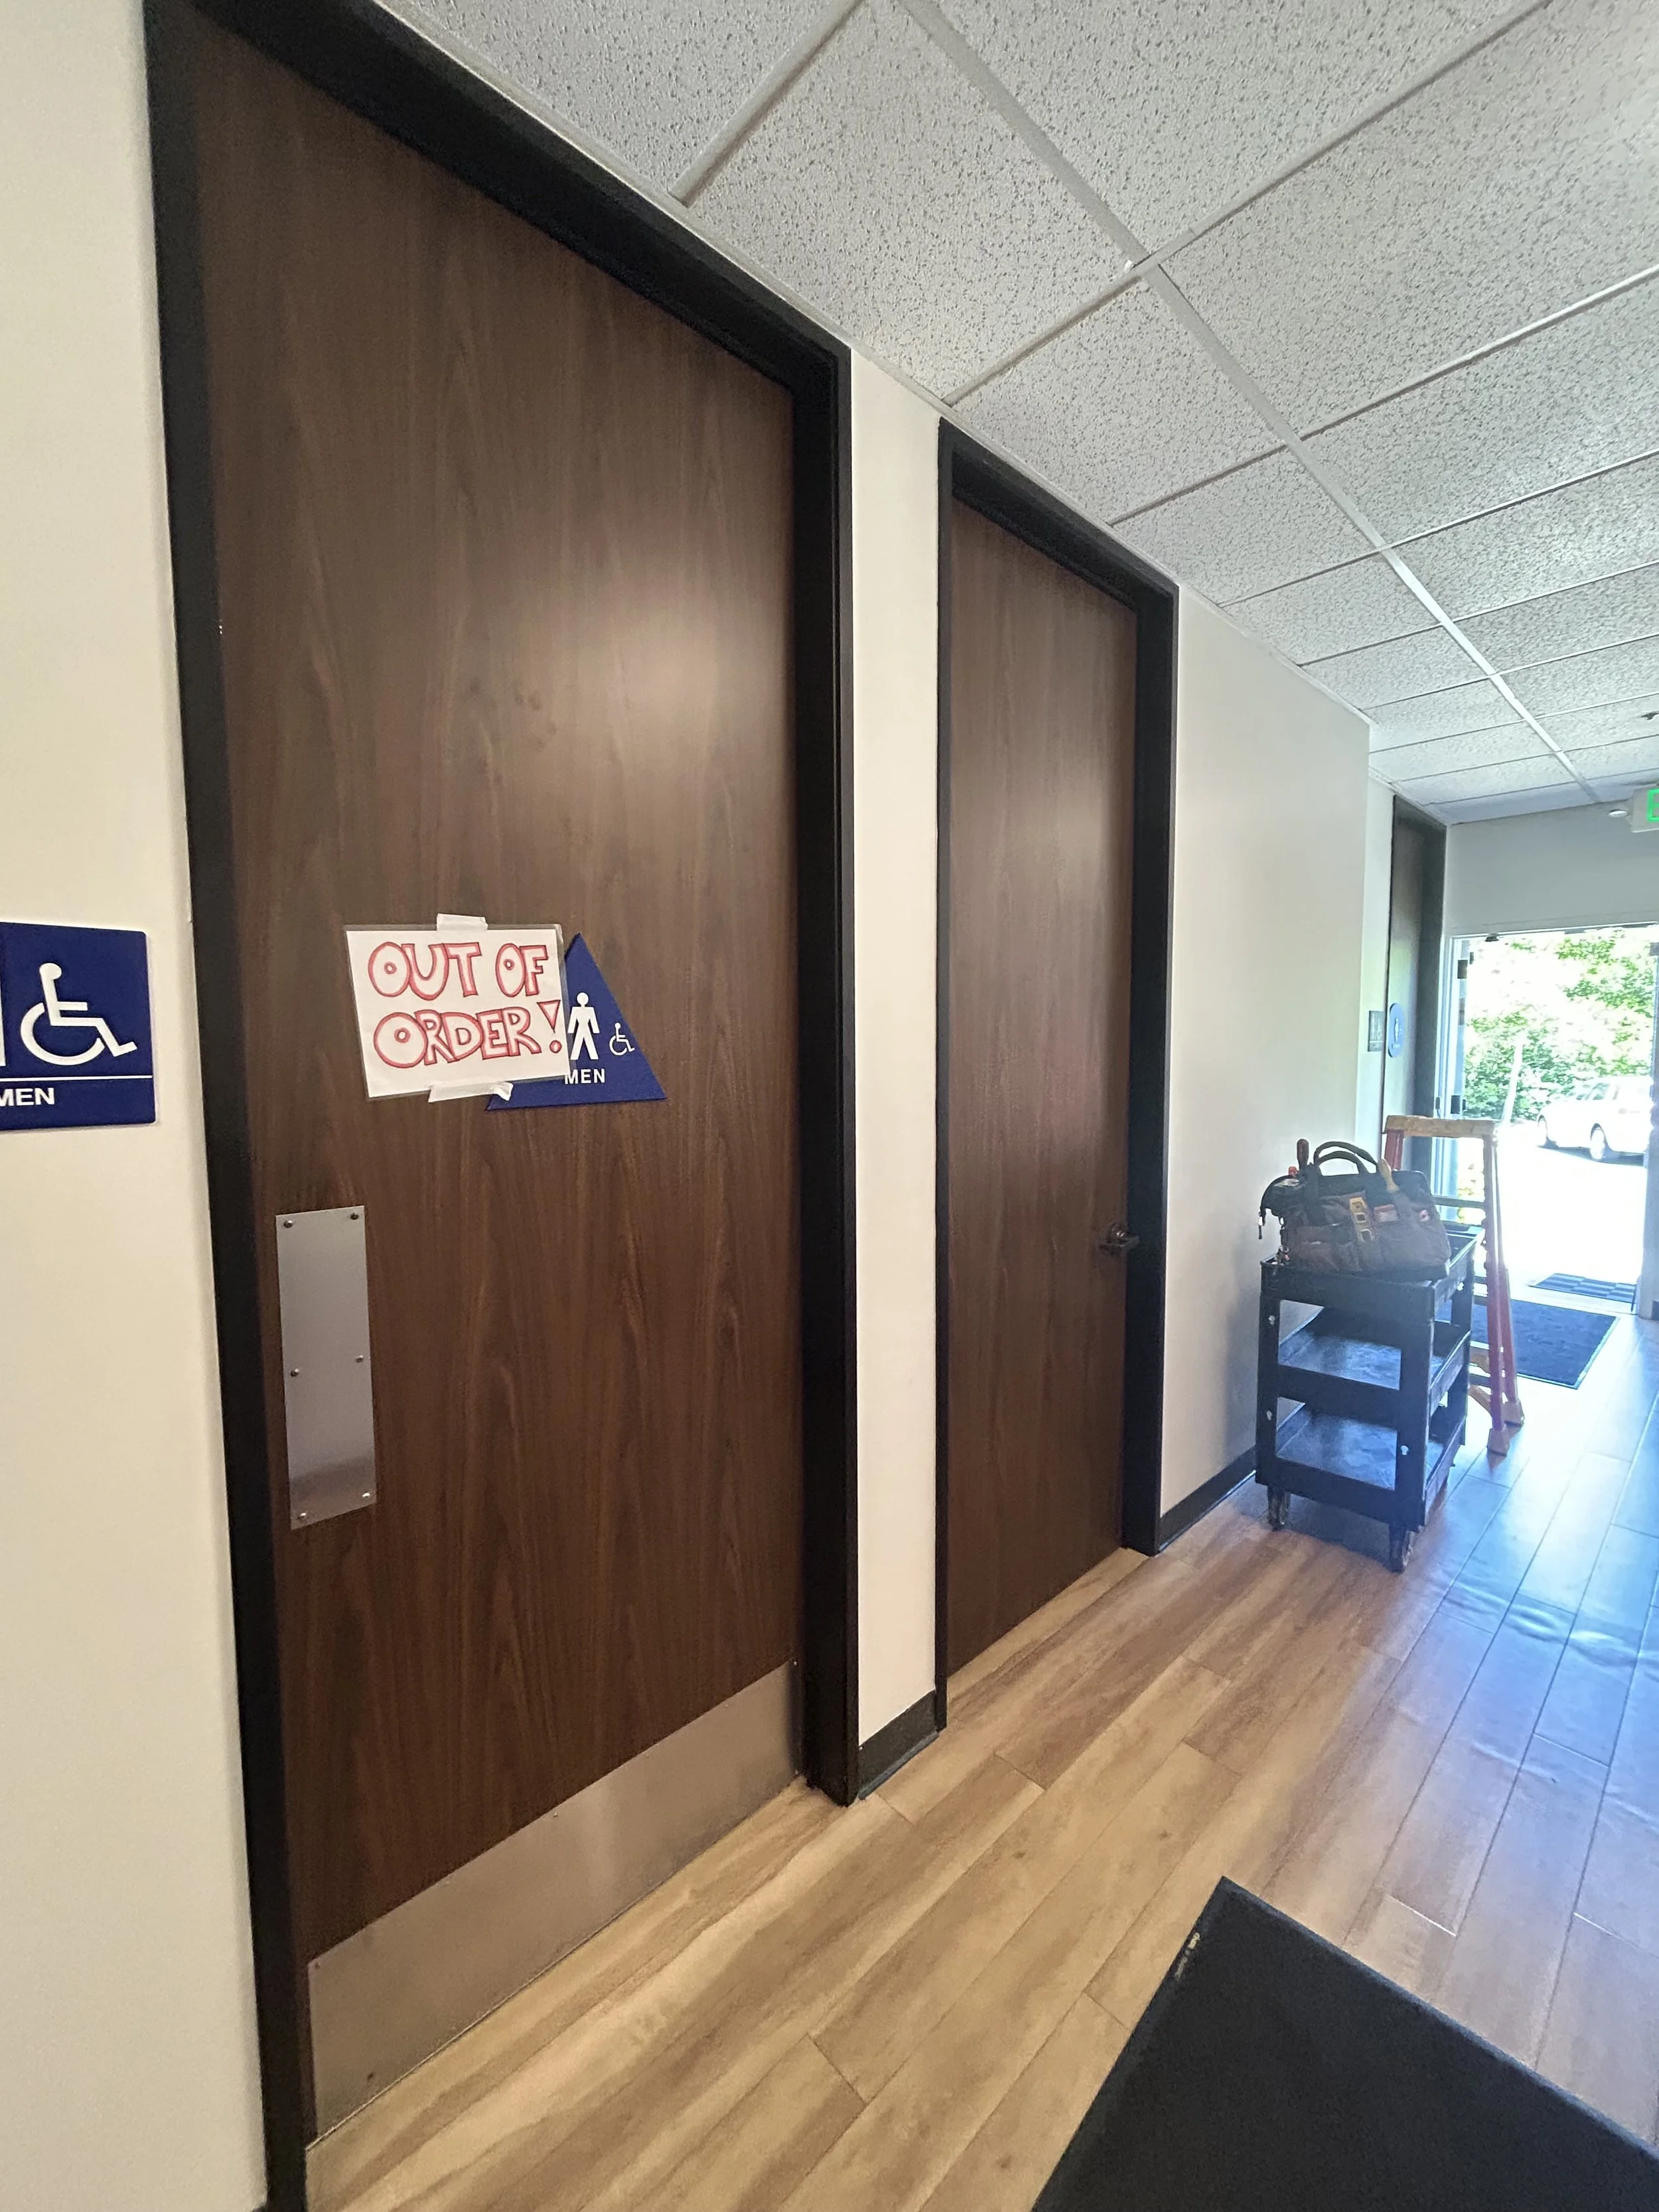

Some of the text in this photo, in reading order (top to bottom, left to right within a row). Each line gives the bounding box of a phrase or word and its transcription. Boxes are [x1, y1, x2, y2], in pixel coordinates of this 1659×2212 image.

[368, 941, 548, 1001] OUT OF
[373, 999, 562, 1069] ORDER!
[565, 1069, 605, 1084] MEN
